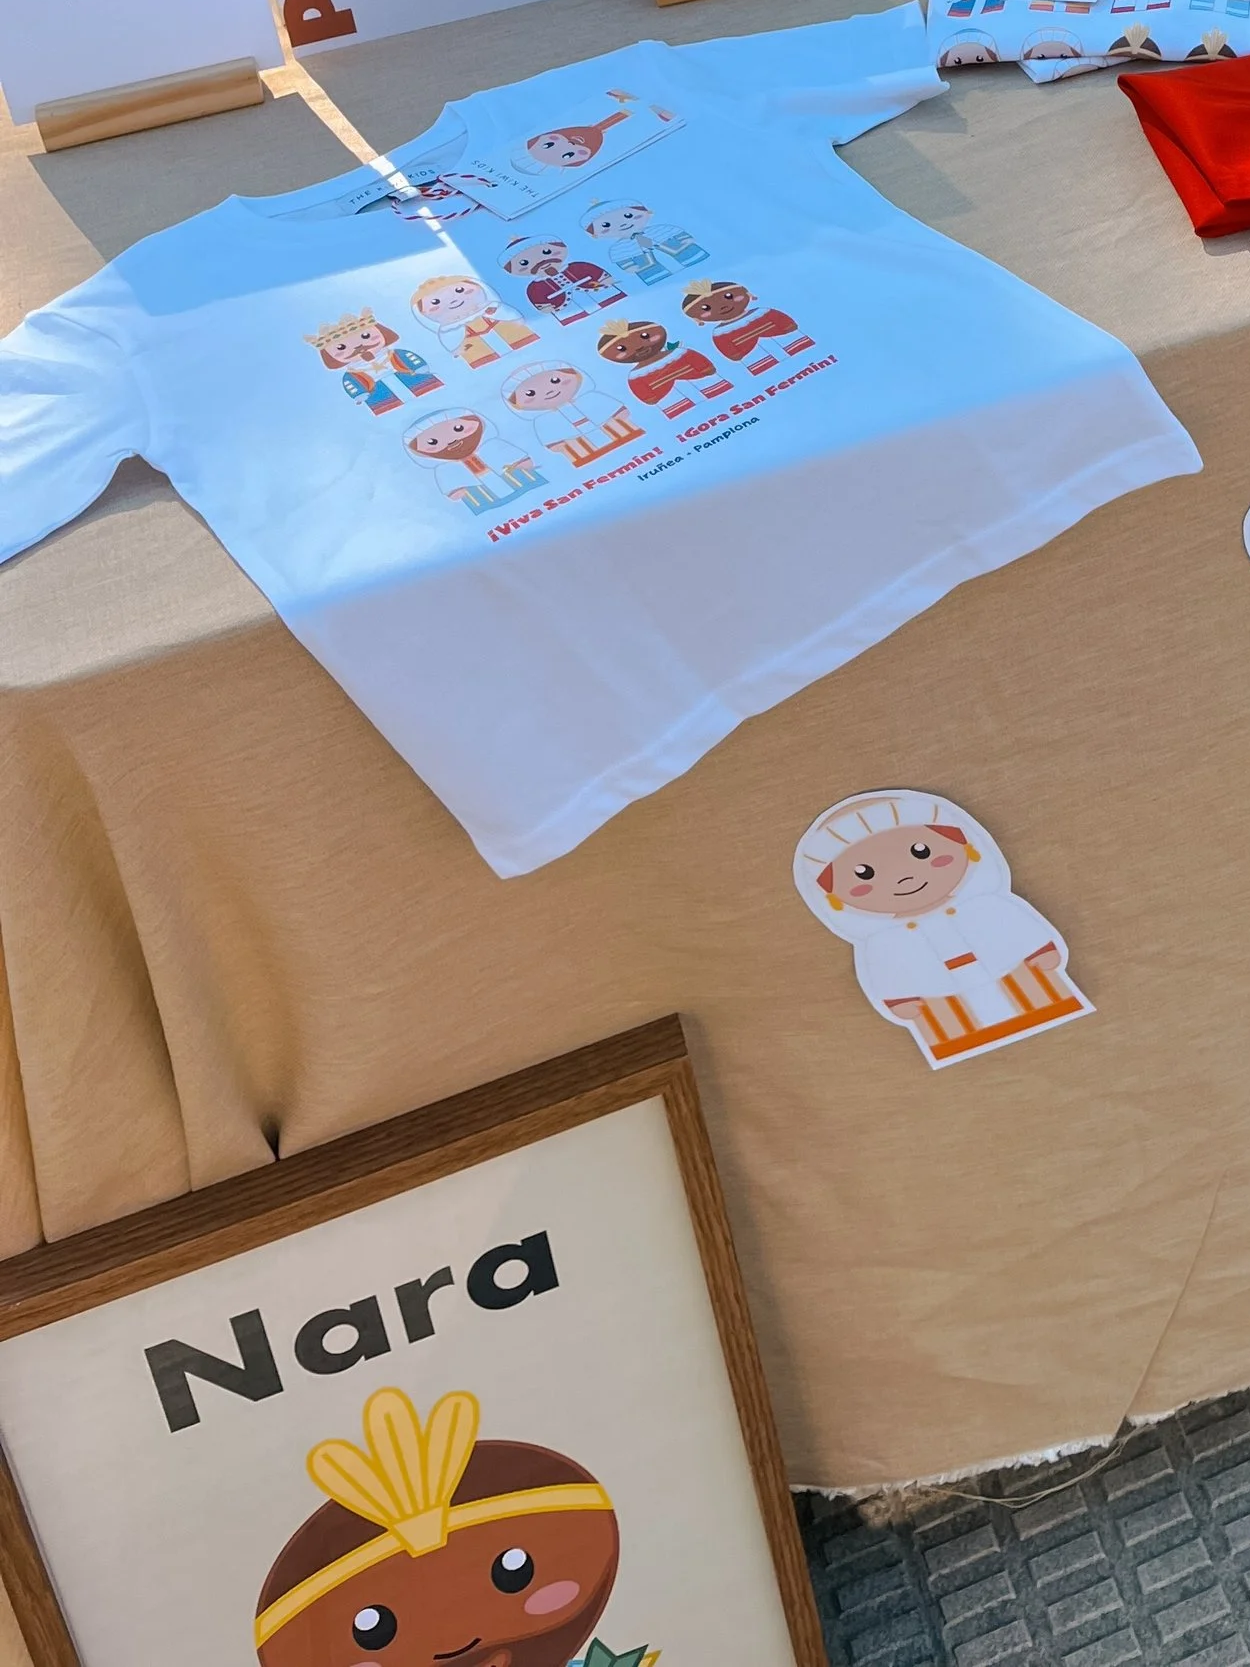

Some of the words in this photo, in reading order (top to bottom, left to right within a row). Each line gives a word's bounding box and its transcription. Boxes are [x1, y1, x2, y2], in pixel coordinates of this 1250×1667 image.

[349, 190, 371, 205] THE
[486, 506, 544, 543] ¡Viva
[543, 487, 584, 511] San
[676, 411, 729, 444] ¡Gora
[729, 392, 767, 417] San
[636, 454, 686, 482] Iruñea
[693, 416, 761, 454] Pamplona
[143, 1229, 560, 1434] Nara
